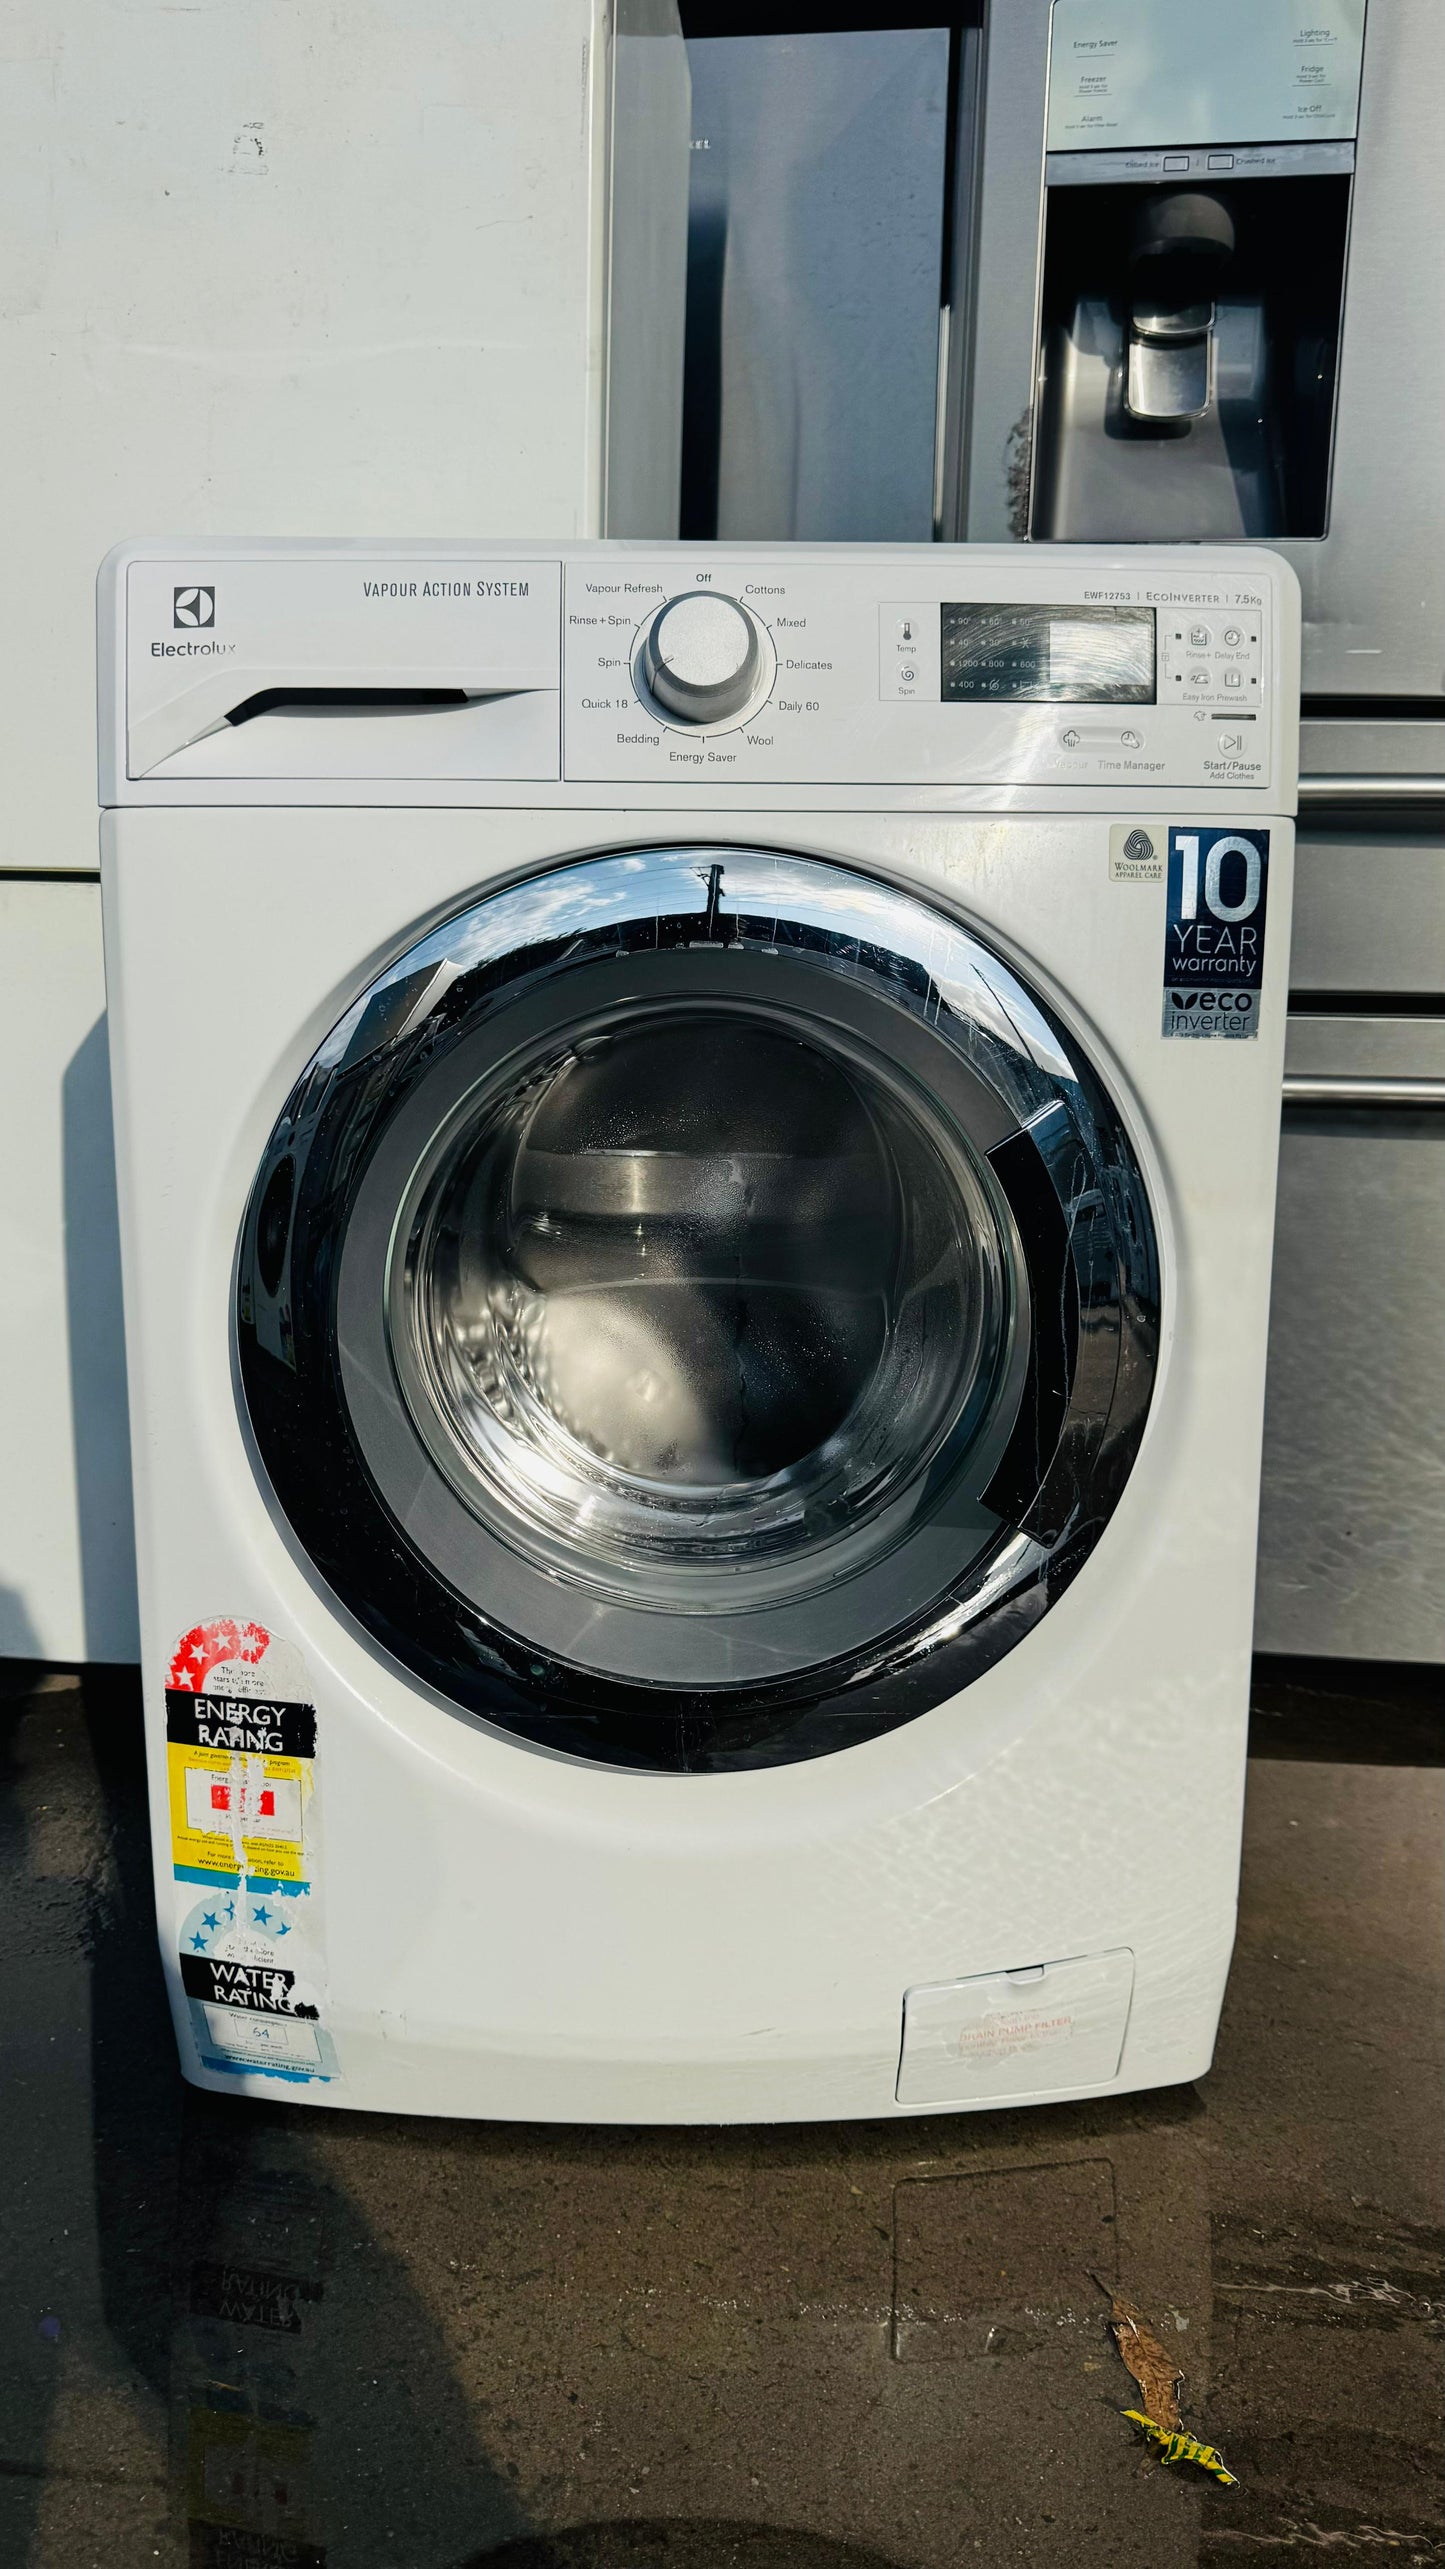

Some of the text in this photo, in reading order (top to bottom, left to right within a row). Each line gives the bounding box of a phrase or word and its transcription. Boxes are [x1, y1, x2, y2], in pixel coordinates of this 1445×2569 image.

[1300, 30, 1330, 38] Lighting
[1073, 40, 1118, 49] Energy Saver
[696, 573, 712, 583] Off
[585, 583, 663, 595] Vapour Refresh
[745, 584, 786, 595] Cottons
[1084, 591, 1131, 600] EWF12753
[776, 618, 807, 628] Mixed
[151, 641, 236, 657] Electrolux
[896, 644, 917, 654] Temp
[1215, 651, 1250, 661] Delay End
[598, 657, 621, 669] Spin
[786, 660, 833, 670] Delicates
[958, 660, 979, 668] 1200
[988, 660, 1005, 668] 800
[958, 681, 975, 689] 400
[898, 686, 915, 696] Spin
[1183, 692, 1215, 702] Easy Iron
[1216, 693, 1247, 702] Prewash
[581, 699, 628, 709] Quick 18
[779, 701, 820, 713] Daily 60
[616, 734, 660, 747] Bedding
[747, 735, 774, 746] Wool
[669, 752, 737, 764] Energy Saver
[1098, 760, 1165, 772] Time Manager
[1203, 760, 1262, 771] Start/Pause
[1209, 772, 1255, 780] Add Clothes
[1175, 835, 1261, 923] 10
[1173, 924, 1257, 956] YEAR
[1172, 956, 1257, 977] warranty
[1199, 992, 1252, 1012] eco
[1171, 1011, 1250, 1031] inverter
[194, 1698, 286, 1727] ENERGY
[198, 1723, 283, 1752] RATING
[209, 1962, 289, 1992] WATER
[213, 1984, 296, 2013] RATING
[1034, 2015, 1072, 2030] FILTER
